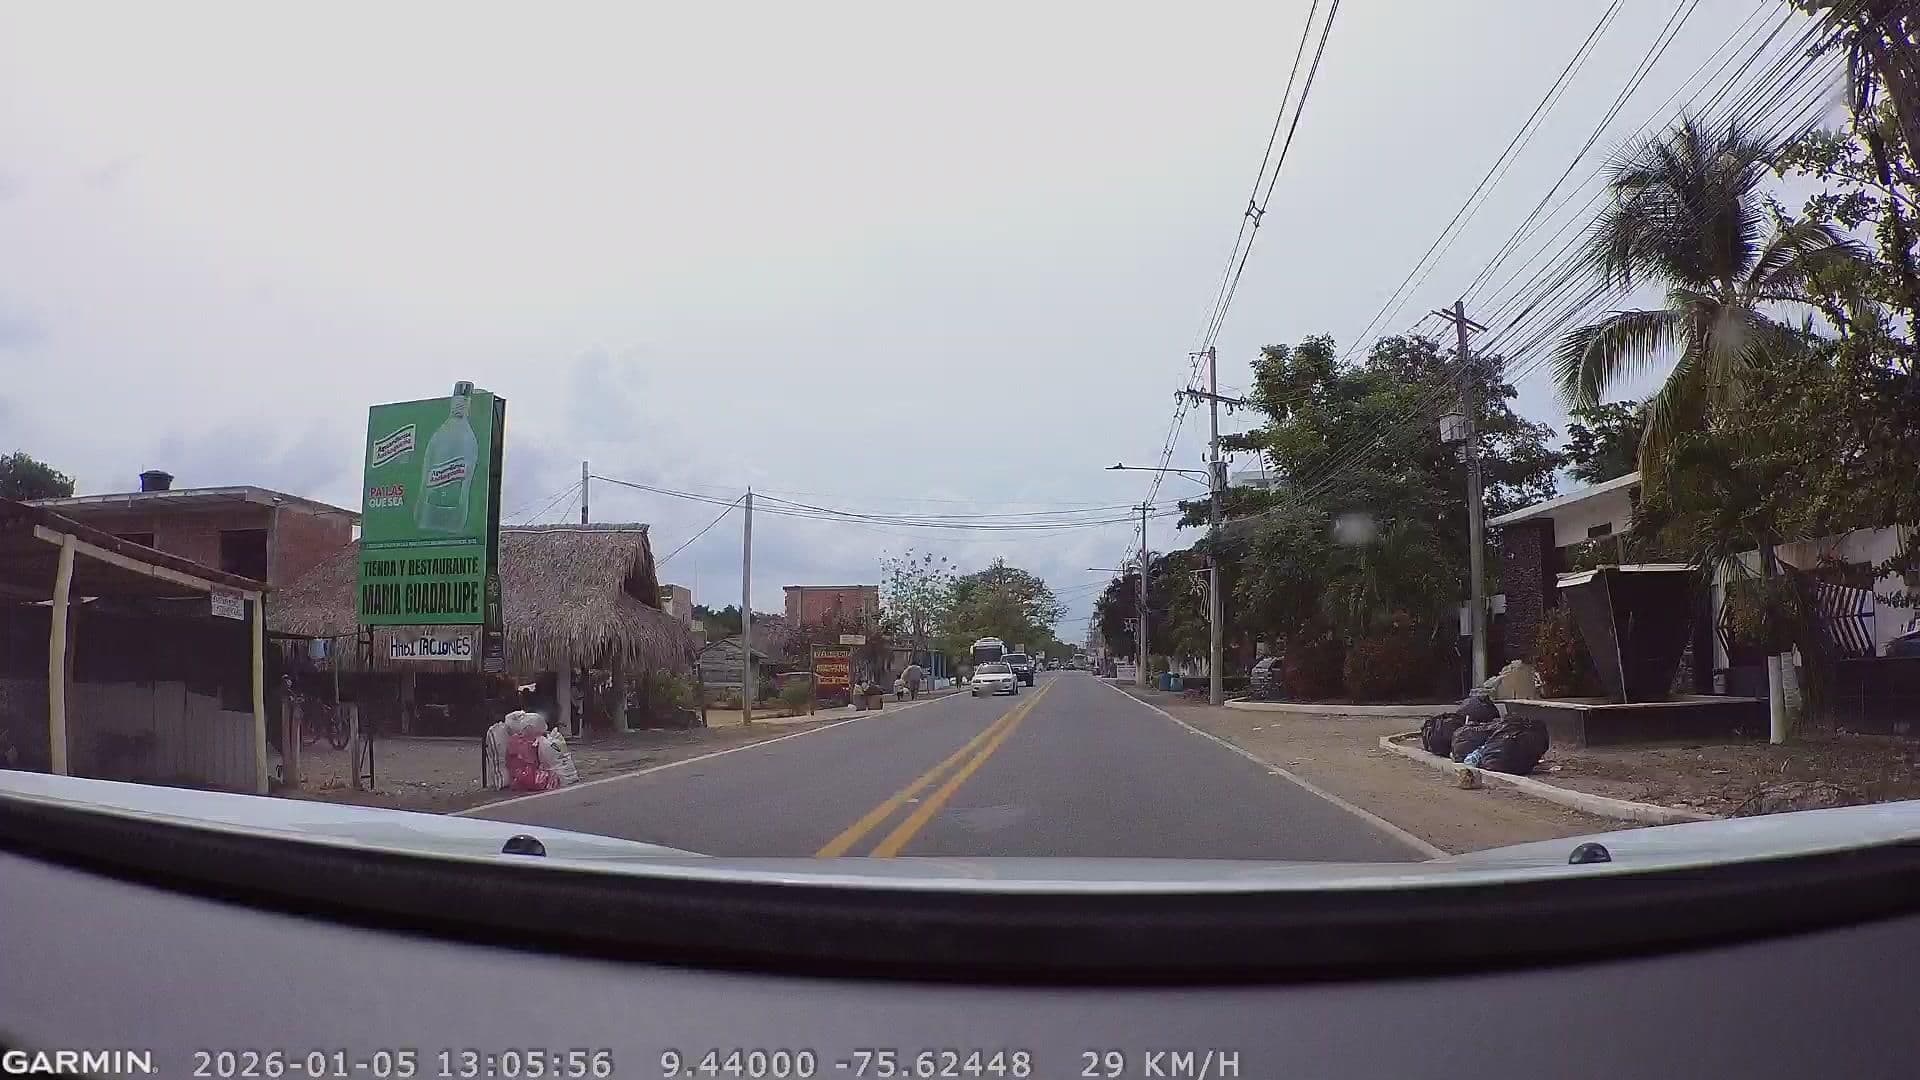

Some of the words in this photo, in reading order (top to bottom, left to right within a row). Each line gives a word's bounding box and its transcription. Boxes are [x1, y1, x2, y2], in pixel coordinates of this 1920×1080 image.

[363, 561, 397, 577] TIENDA
[399, 560, 406, 577] Y
[408, 557, 479, 577] RESTAURANTE
[362, 583, 401, 616] MARIA
[405, 581, 479, 614] GUADALUPE
